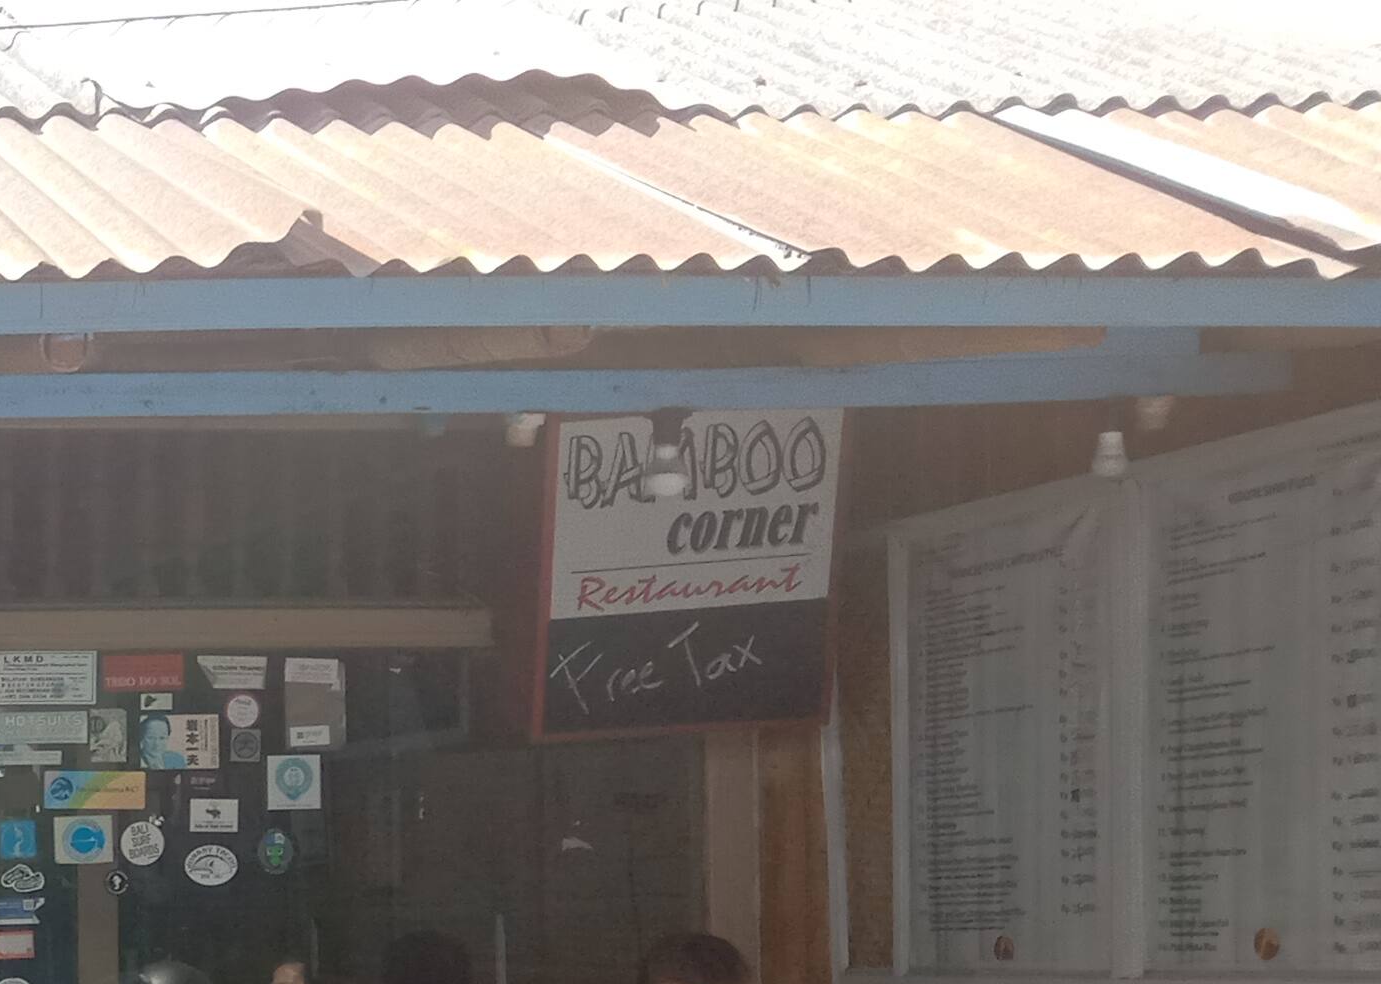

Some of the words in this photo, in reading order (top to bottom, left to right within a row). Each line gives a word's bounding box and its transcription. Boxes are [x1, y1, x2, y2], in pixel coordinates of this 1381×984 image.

[666, 502, 819, 556] corner
[577, 563, 804, 612] Restaurant
[549, 640, 668, 716] Free
[667, 621, 762, 688] Tax
